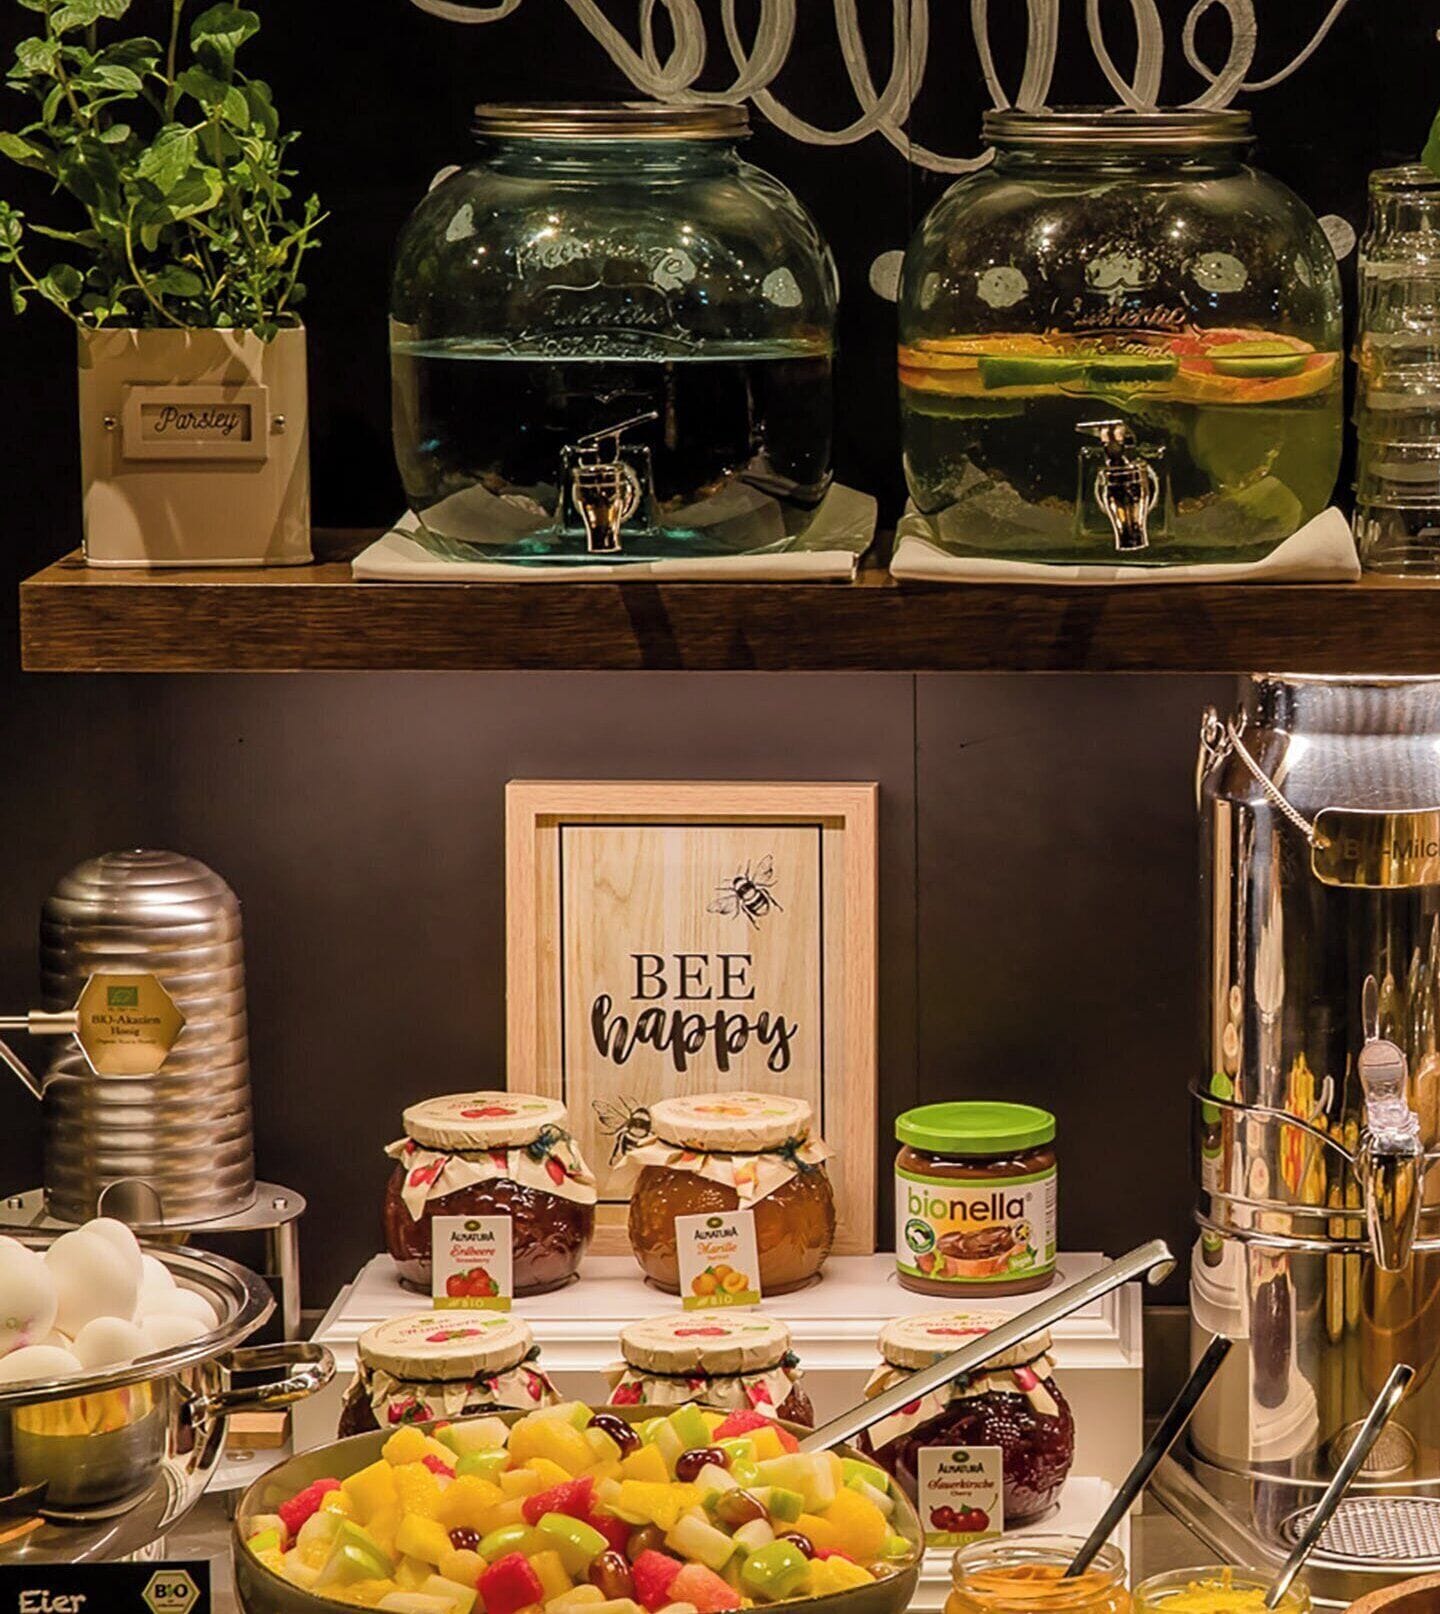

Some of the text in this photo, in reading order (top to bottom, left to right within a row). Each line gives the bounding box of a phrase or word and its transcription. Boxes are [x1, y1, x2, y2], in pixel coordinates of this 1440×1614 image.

[154, 405, 239, 436] Parsley
[630, 953, 756, 1000] BEE
[111, 1026, 140, 1037] Honig
[591, 994, 798, 1073] happy
[908, 1186, 1024, 1221] bionella
[450, 1231, 495, 1242] ALNATURA
[694, 1226, 738, 1240] ALNATURA
[450, 1244, 496, 1257] Erdbeere
[937, 1462, 984, 1474] ALNATURA
[18, 1588, 87, 1614] Eier
